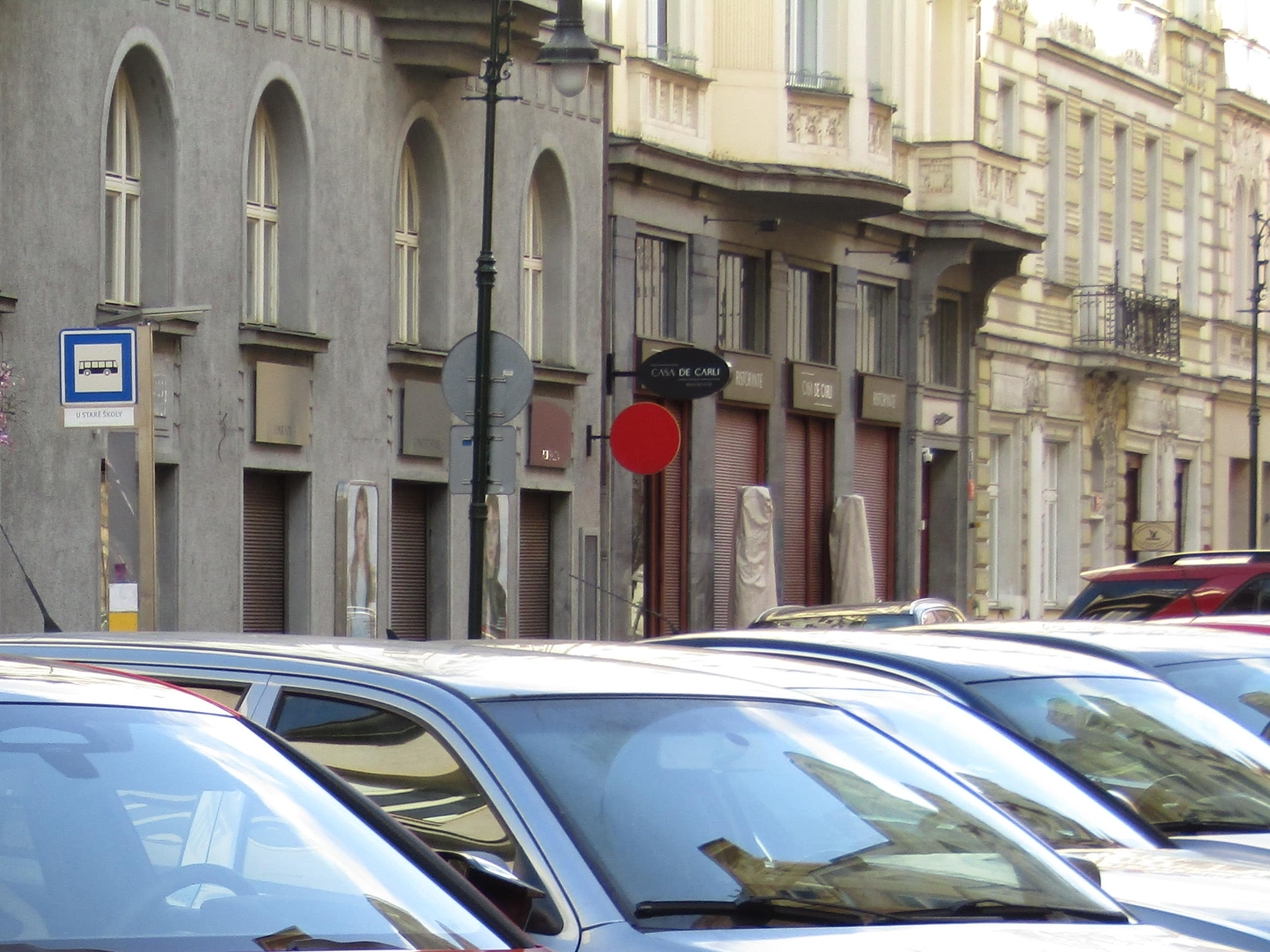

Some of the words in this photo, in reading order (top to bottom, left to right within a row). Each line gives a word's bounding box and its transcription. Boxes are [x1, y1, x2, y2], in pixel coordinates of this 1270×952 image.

[651, 368, 676, 377] CASA
[679, 368, 691, 377] DE
[694, 368, 720, 377] CARLI
[735, 370, 763, 389] RISTORANTE
[813, 382, 820, 397] DE
[821, 383, 833, 399] CARLI
